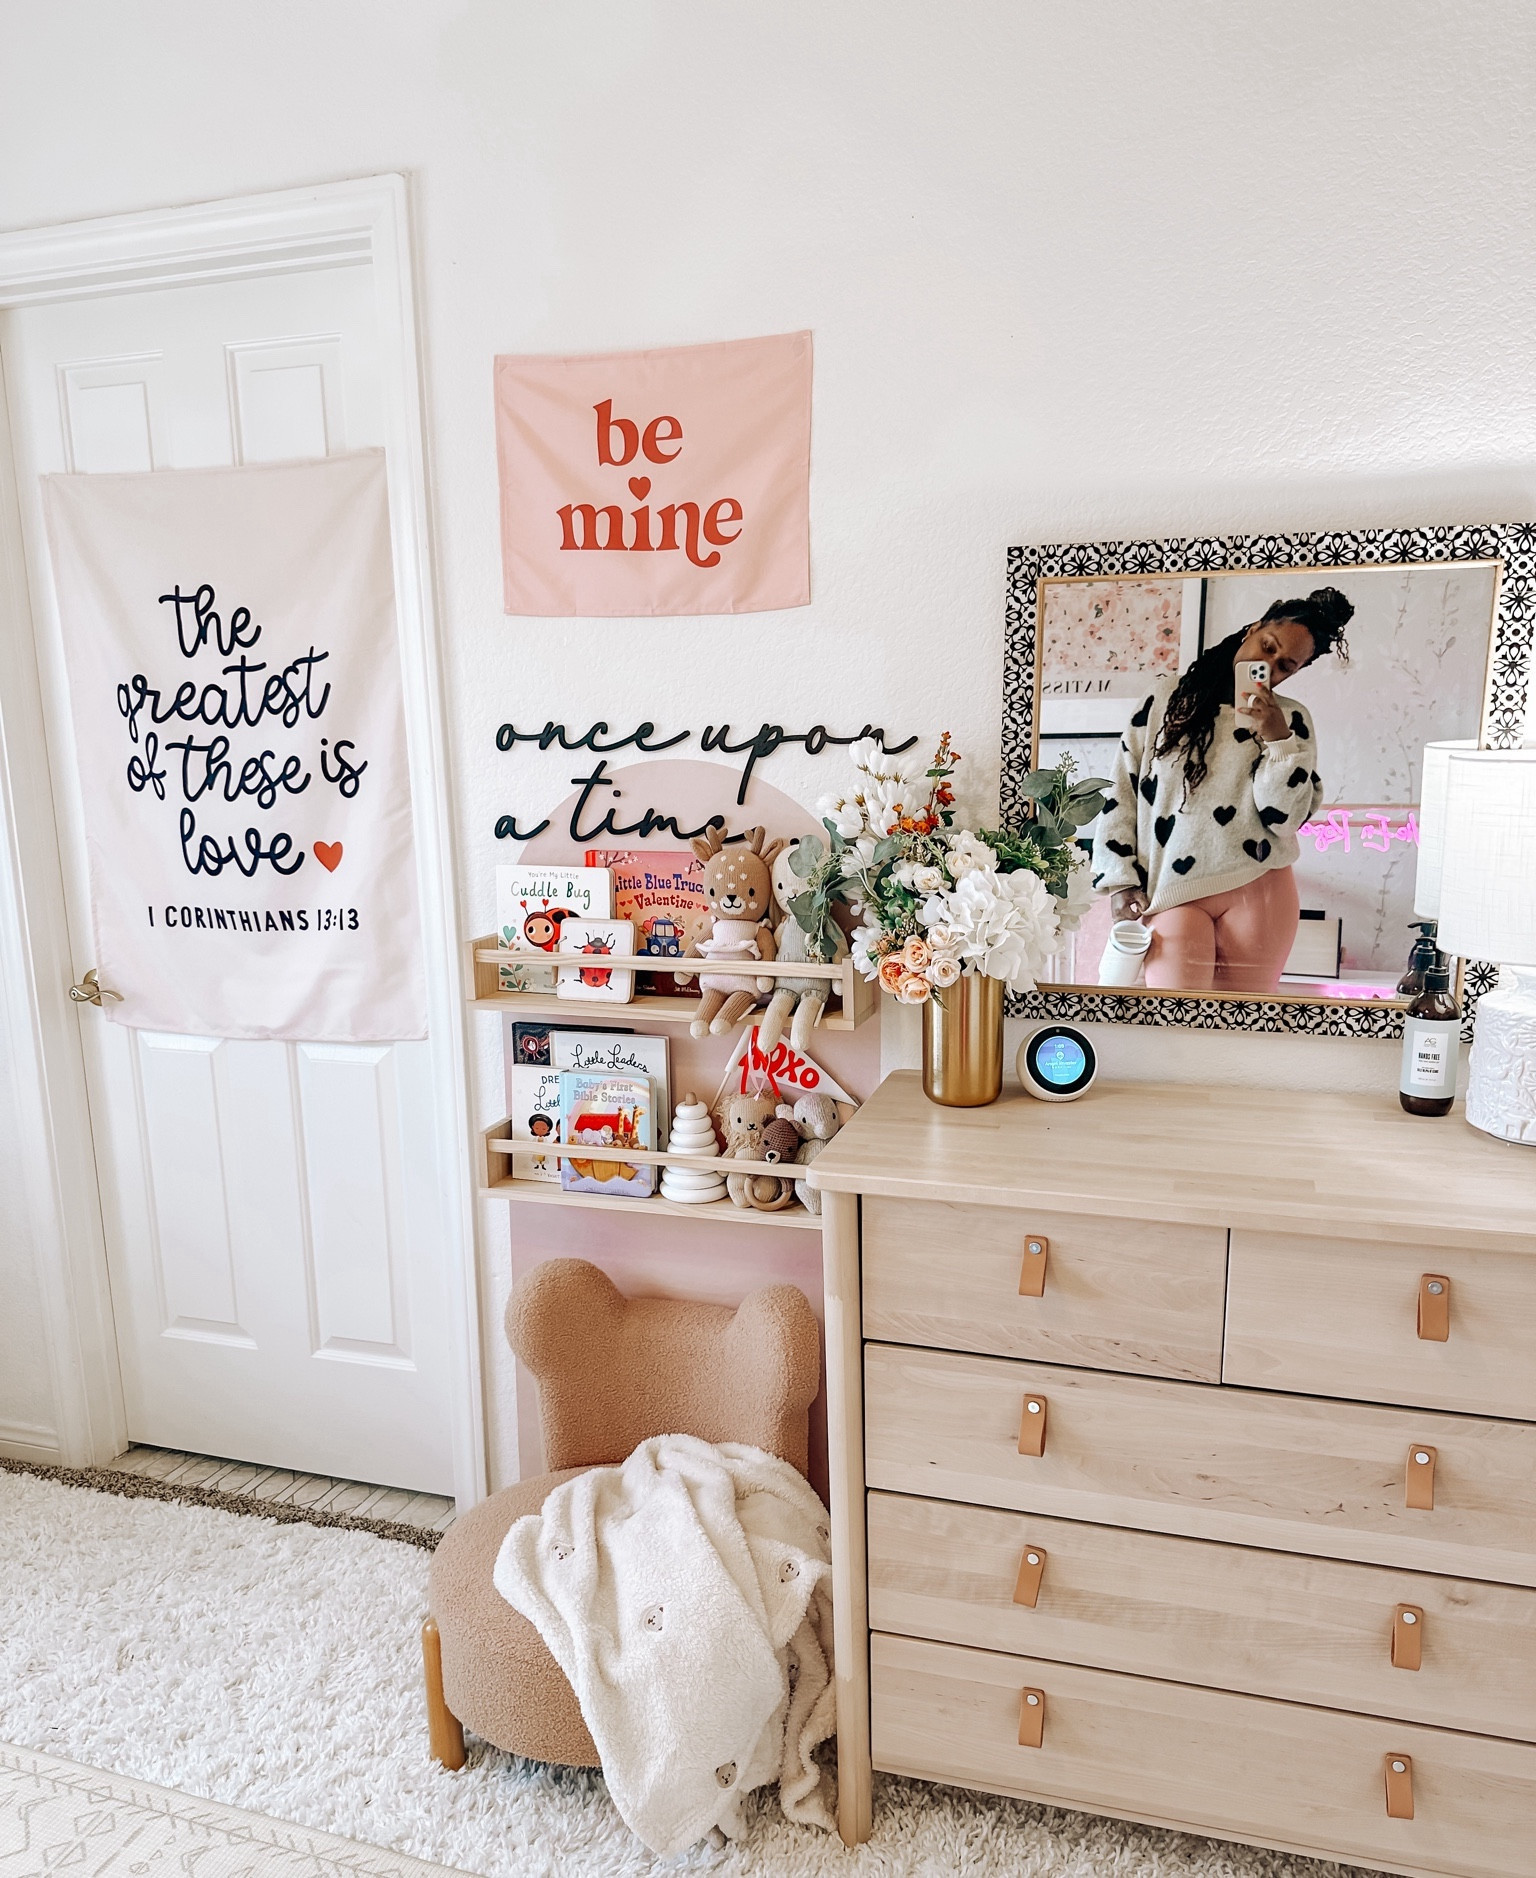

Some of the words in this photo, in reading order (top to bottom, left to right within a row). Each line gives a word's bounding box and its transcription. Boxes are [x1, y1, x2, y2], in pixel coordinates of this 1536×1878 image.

[592, 398, 683, 467] be
[555, 484, 744, 568] mine
[158, 584, 262, 658] the
[117, 646, 332, 743] greatest
[127, 732, 167, 800] of
[165, 735, 312, 810] these
[321, 738, 368, 798] is
[495, 721, 691, 752] once
[700, 723, 919, 805] upon
[180, 807, 305, 877] love
[494, 814, 550, 841] a
[549, 872, 559, 880] My
[560, 872, 580, 880] Little
[615, 875, 642, 893] ittle
[644, 873, 672, 889] Blue
[672, 873, 705, 895] Truc
[510, 881, 559, 898] Cuddle
[566, 882, 591, 911] Bug
[633, 892, 694, 910] Valentine
[165, 905, 309, 932] CORINTHIANS
[317, 907, 360, 931] 13:13
[570, 1043, 606, 1069] Little
[607, 1043, 650, 1074] Leaders
[573, 1090, 599, 1102] Bible
[601, 1094, 636, 1105] Stories
[575, 1078, 608, 1092] Baby's
[610, 1080, 634, 1092] First
